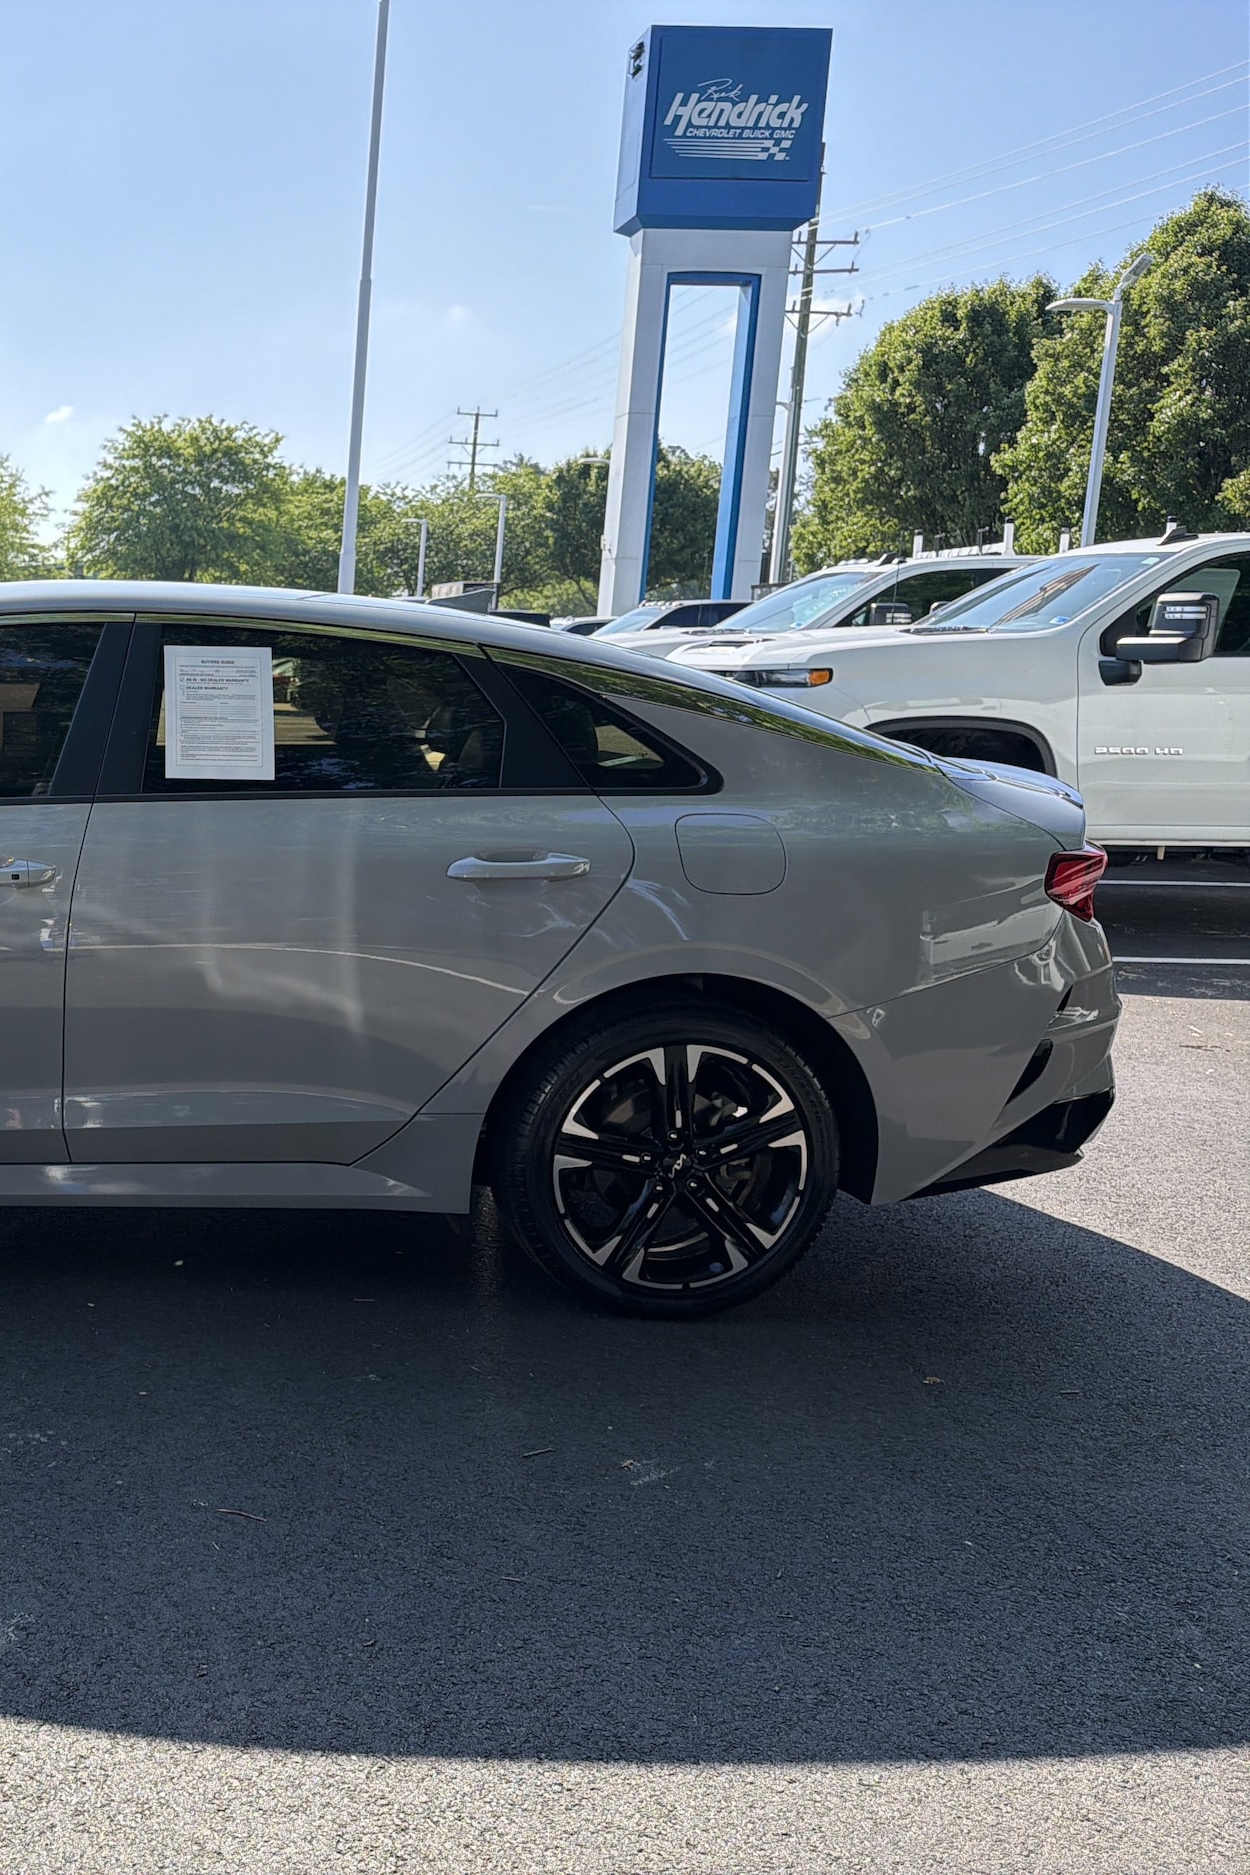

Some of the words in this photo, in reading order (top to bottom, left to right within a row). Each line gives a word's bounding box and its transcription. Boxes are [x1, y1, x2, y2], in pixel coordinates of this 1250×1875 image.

[663, 92, 809, 136] Hendrick
[686, 129, 741, 138] CHEVROLET
[742, 129, 772, 138] BUICK
[773, 130, 796, 139] GMC
[1094, 746, 1149, 756] 2500
[1154, 747, 1183, 756] HD
